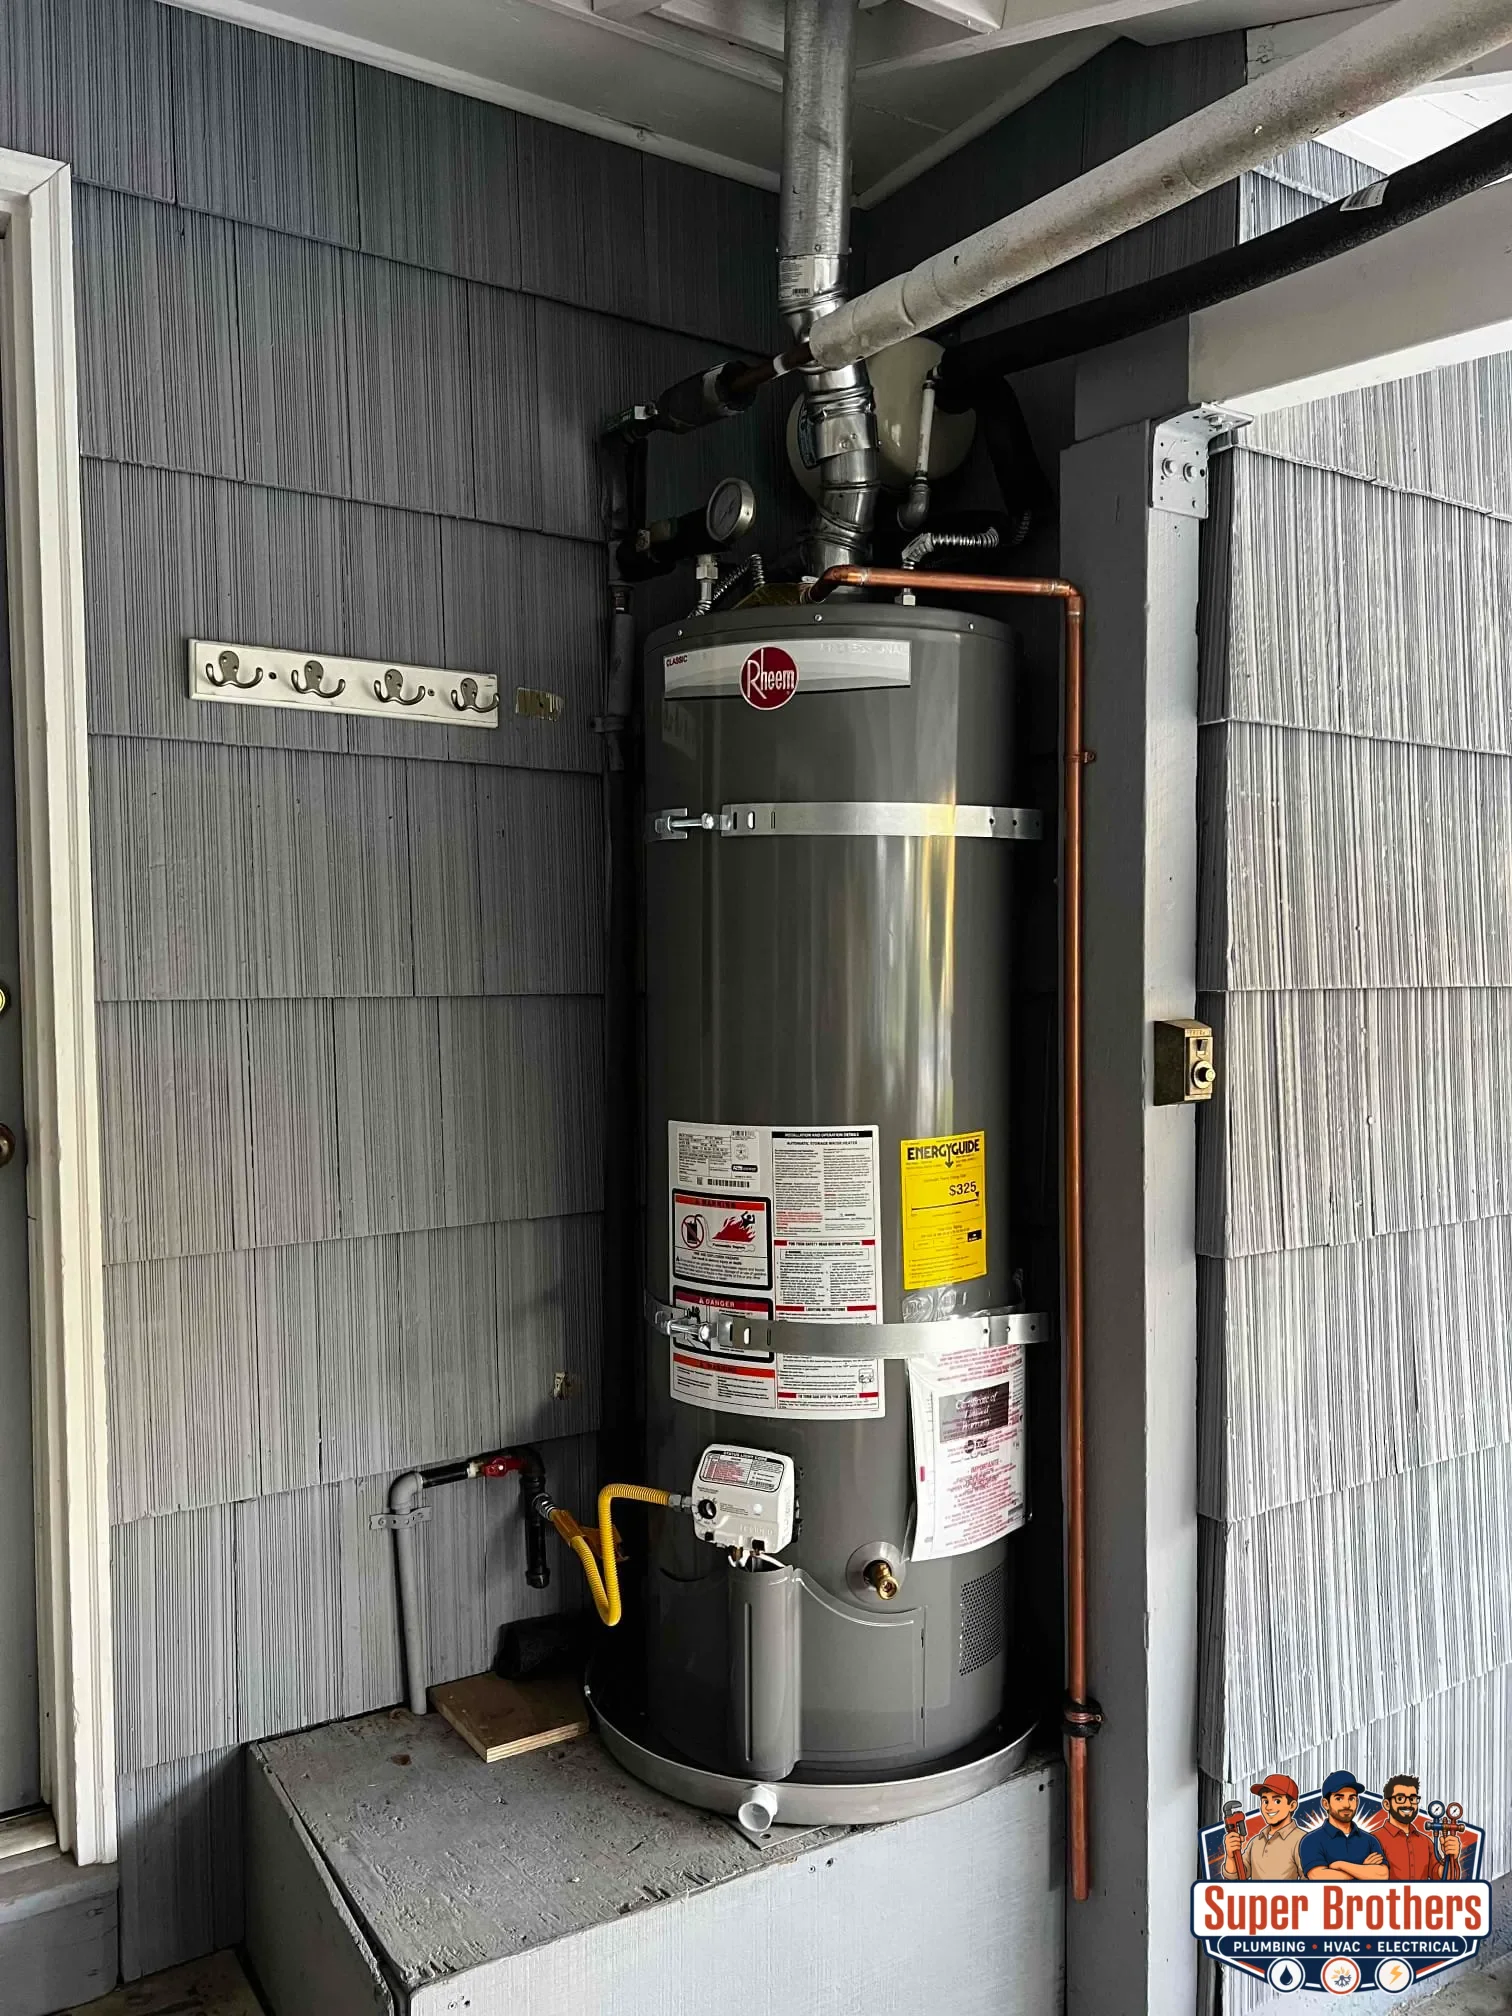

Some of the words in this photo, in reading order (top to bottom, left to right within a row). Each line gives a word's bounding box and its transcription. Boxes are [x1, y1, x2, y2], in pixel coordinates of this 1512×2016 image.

[666, 655, 688, 667] CLASSIC
[747, 648, 795, 700] Rheem
[907, 1138, 980, 1162] ENERGYGUIDE
[705, 1299, 735, 1308] DANGER
